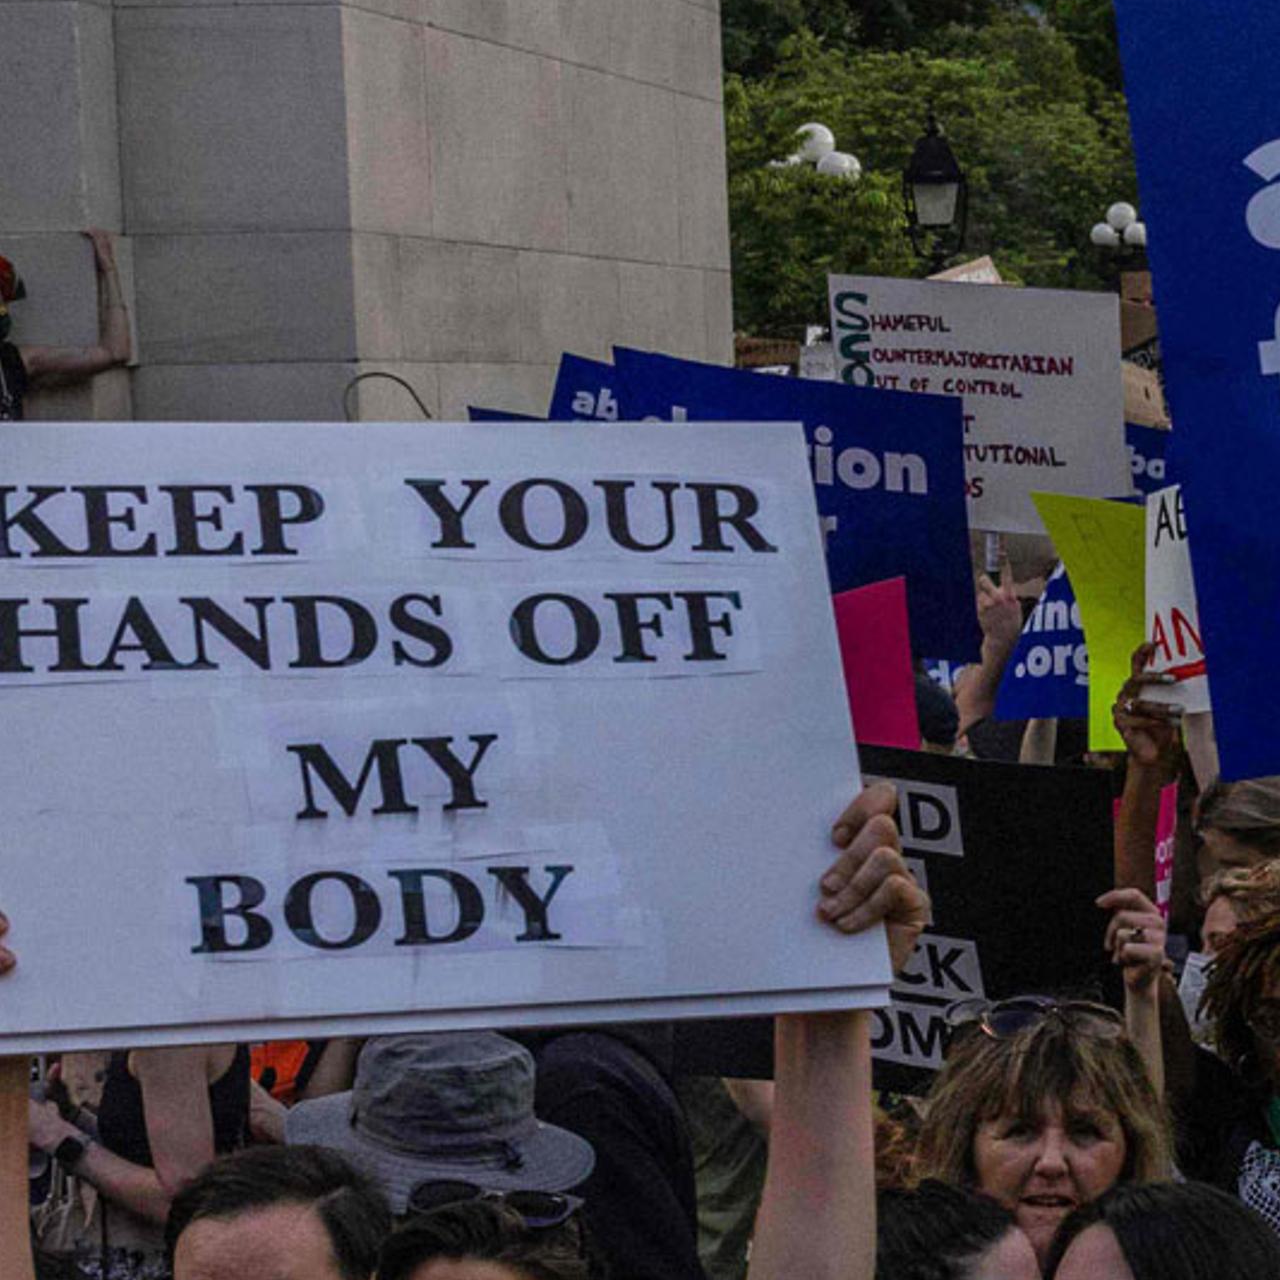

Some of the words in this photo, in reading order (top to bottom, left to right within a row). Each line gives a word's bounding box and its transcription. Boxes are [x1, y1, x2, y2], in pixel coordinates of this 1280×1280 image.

[809, 425, 928, 494] ion
[0, 484, 325, 558] KEEP
[404, 478, 778, 552] YOUR
[0, 593, 453, 672] HANDS
[509, 591, 742, 666] OFF
[286, 734, 498, 820] MY
[185, 865, 574, 955] BODY
